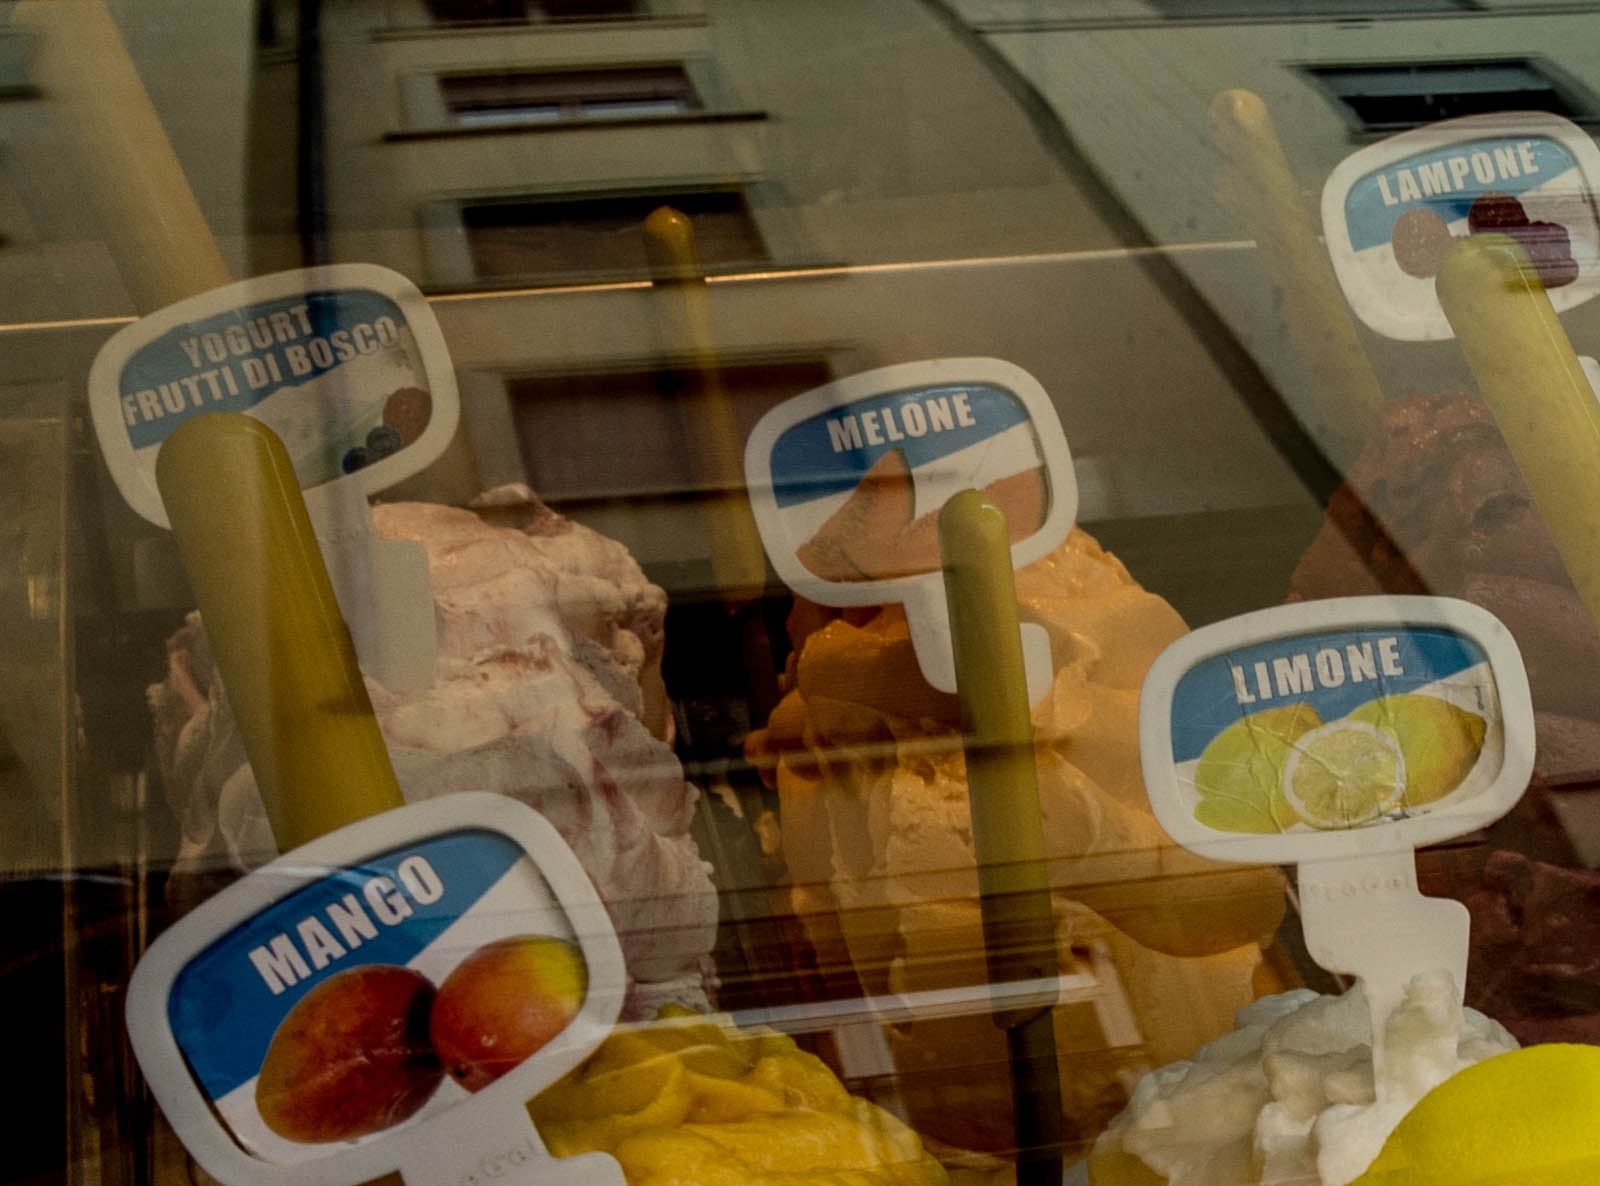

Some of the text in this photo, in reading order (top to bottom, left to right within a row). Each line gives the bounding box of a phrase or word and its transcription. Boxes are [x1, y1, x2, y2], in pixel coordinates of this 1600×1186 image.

[1377, 142, 1539, 206] LAMPONE
[179, 304, 315, 368] YOGURT
[121, 314, 399, 426] FRUTTI DI BOSCO
[826, 393, 976, 453] MELONE
[1231, 637, 1403, 704] LIMONE
[248, 855, 445, 995] MANGO
